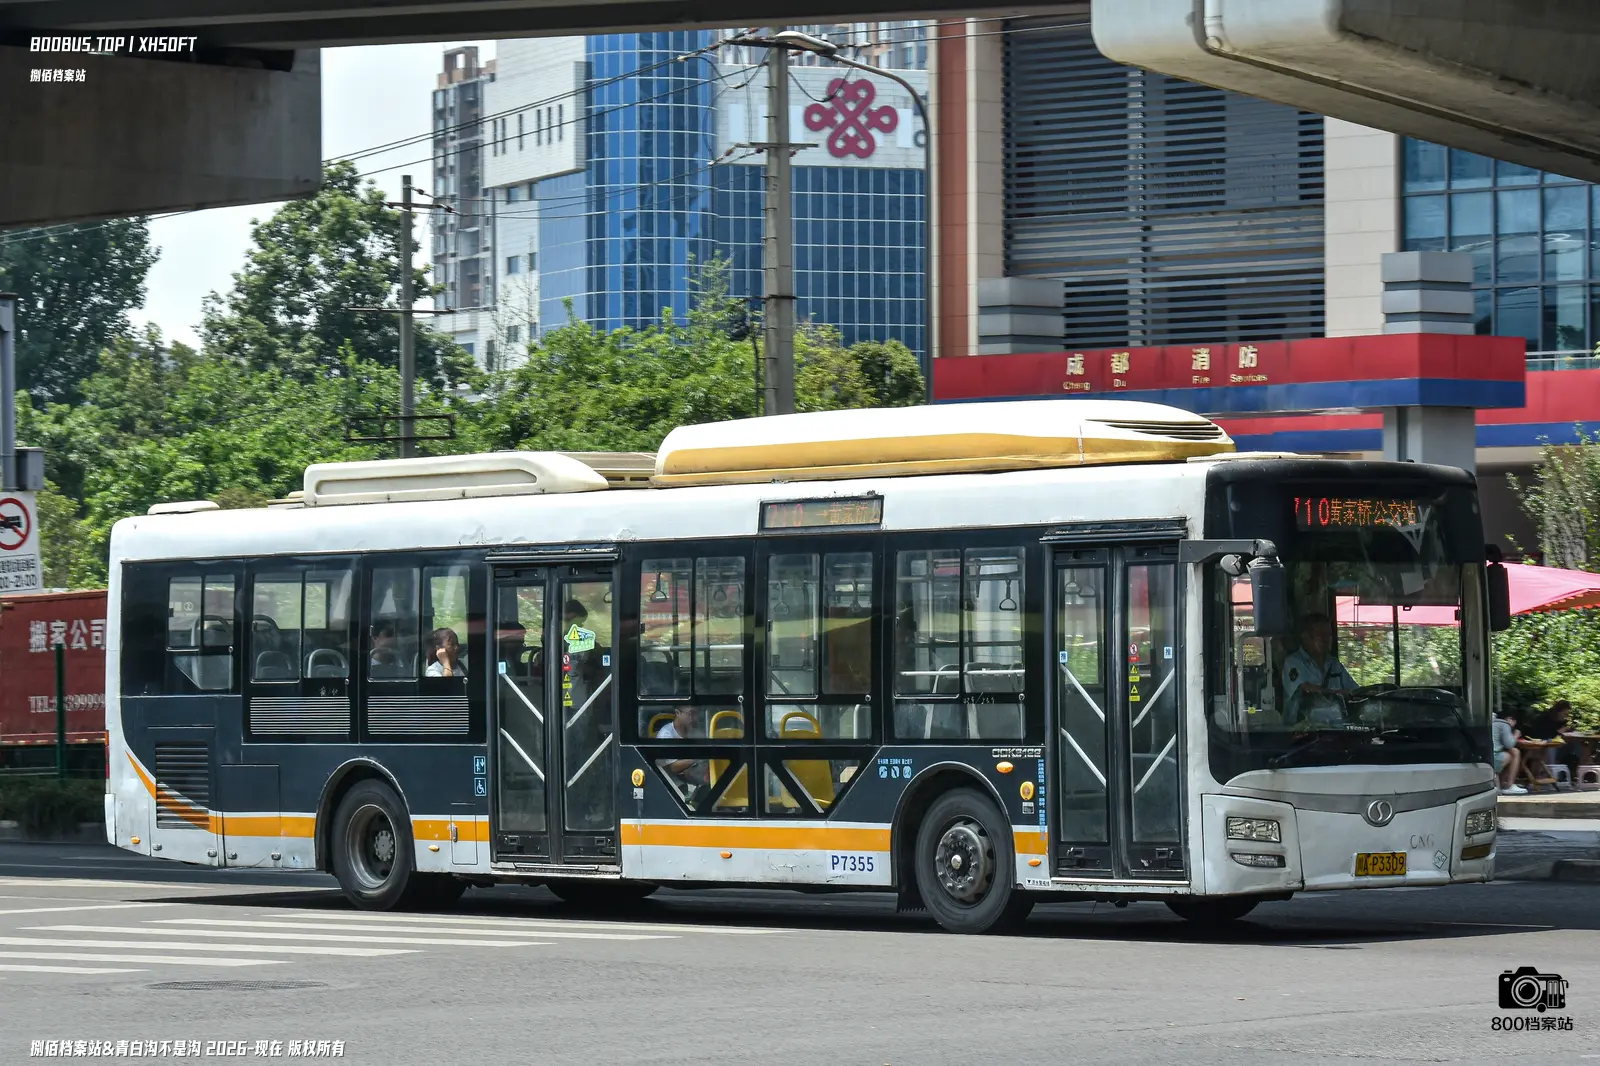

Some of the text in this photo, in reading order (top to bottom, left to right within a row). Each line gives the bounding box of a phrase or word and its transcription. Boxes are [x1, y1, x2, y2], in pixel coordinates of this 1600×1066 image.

[1066, 345, 1259, 376] 成都 消防
[1192, 375, 1211, 385] Fire
[1331, 498, 1417, 527] 黄家桥公交站
[29, 619, 107, 653] 搬家公司
[831, 855, 874, 872] P7355
